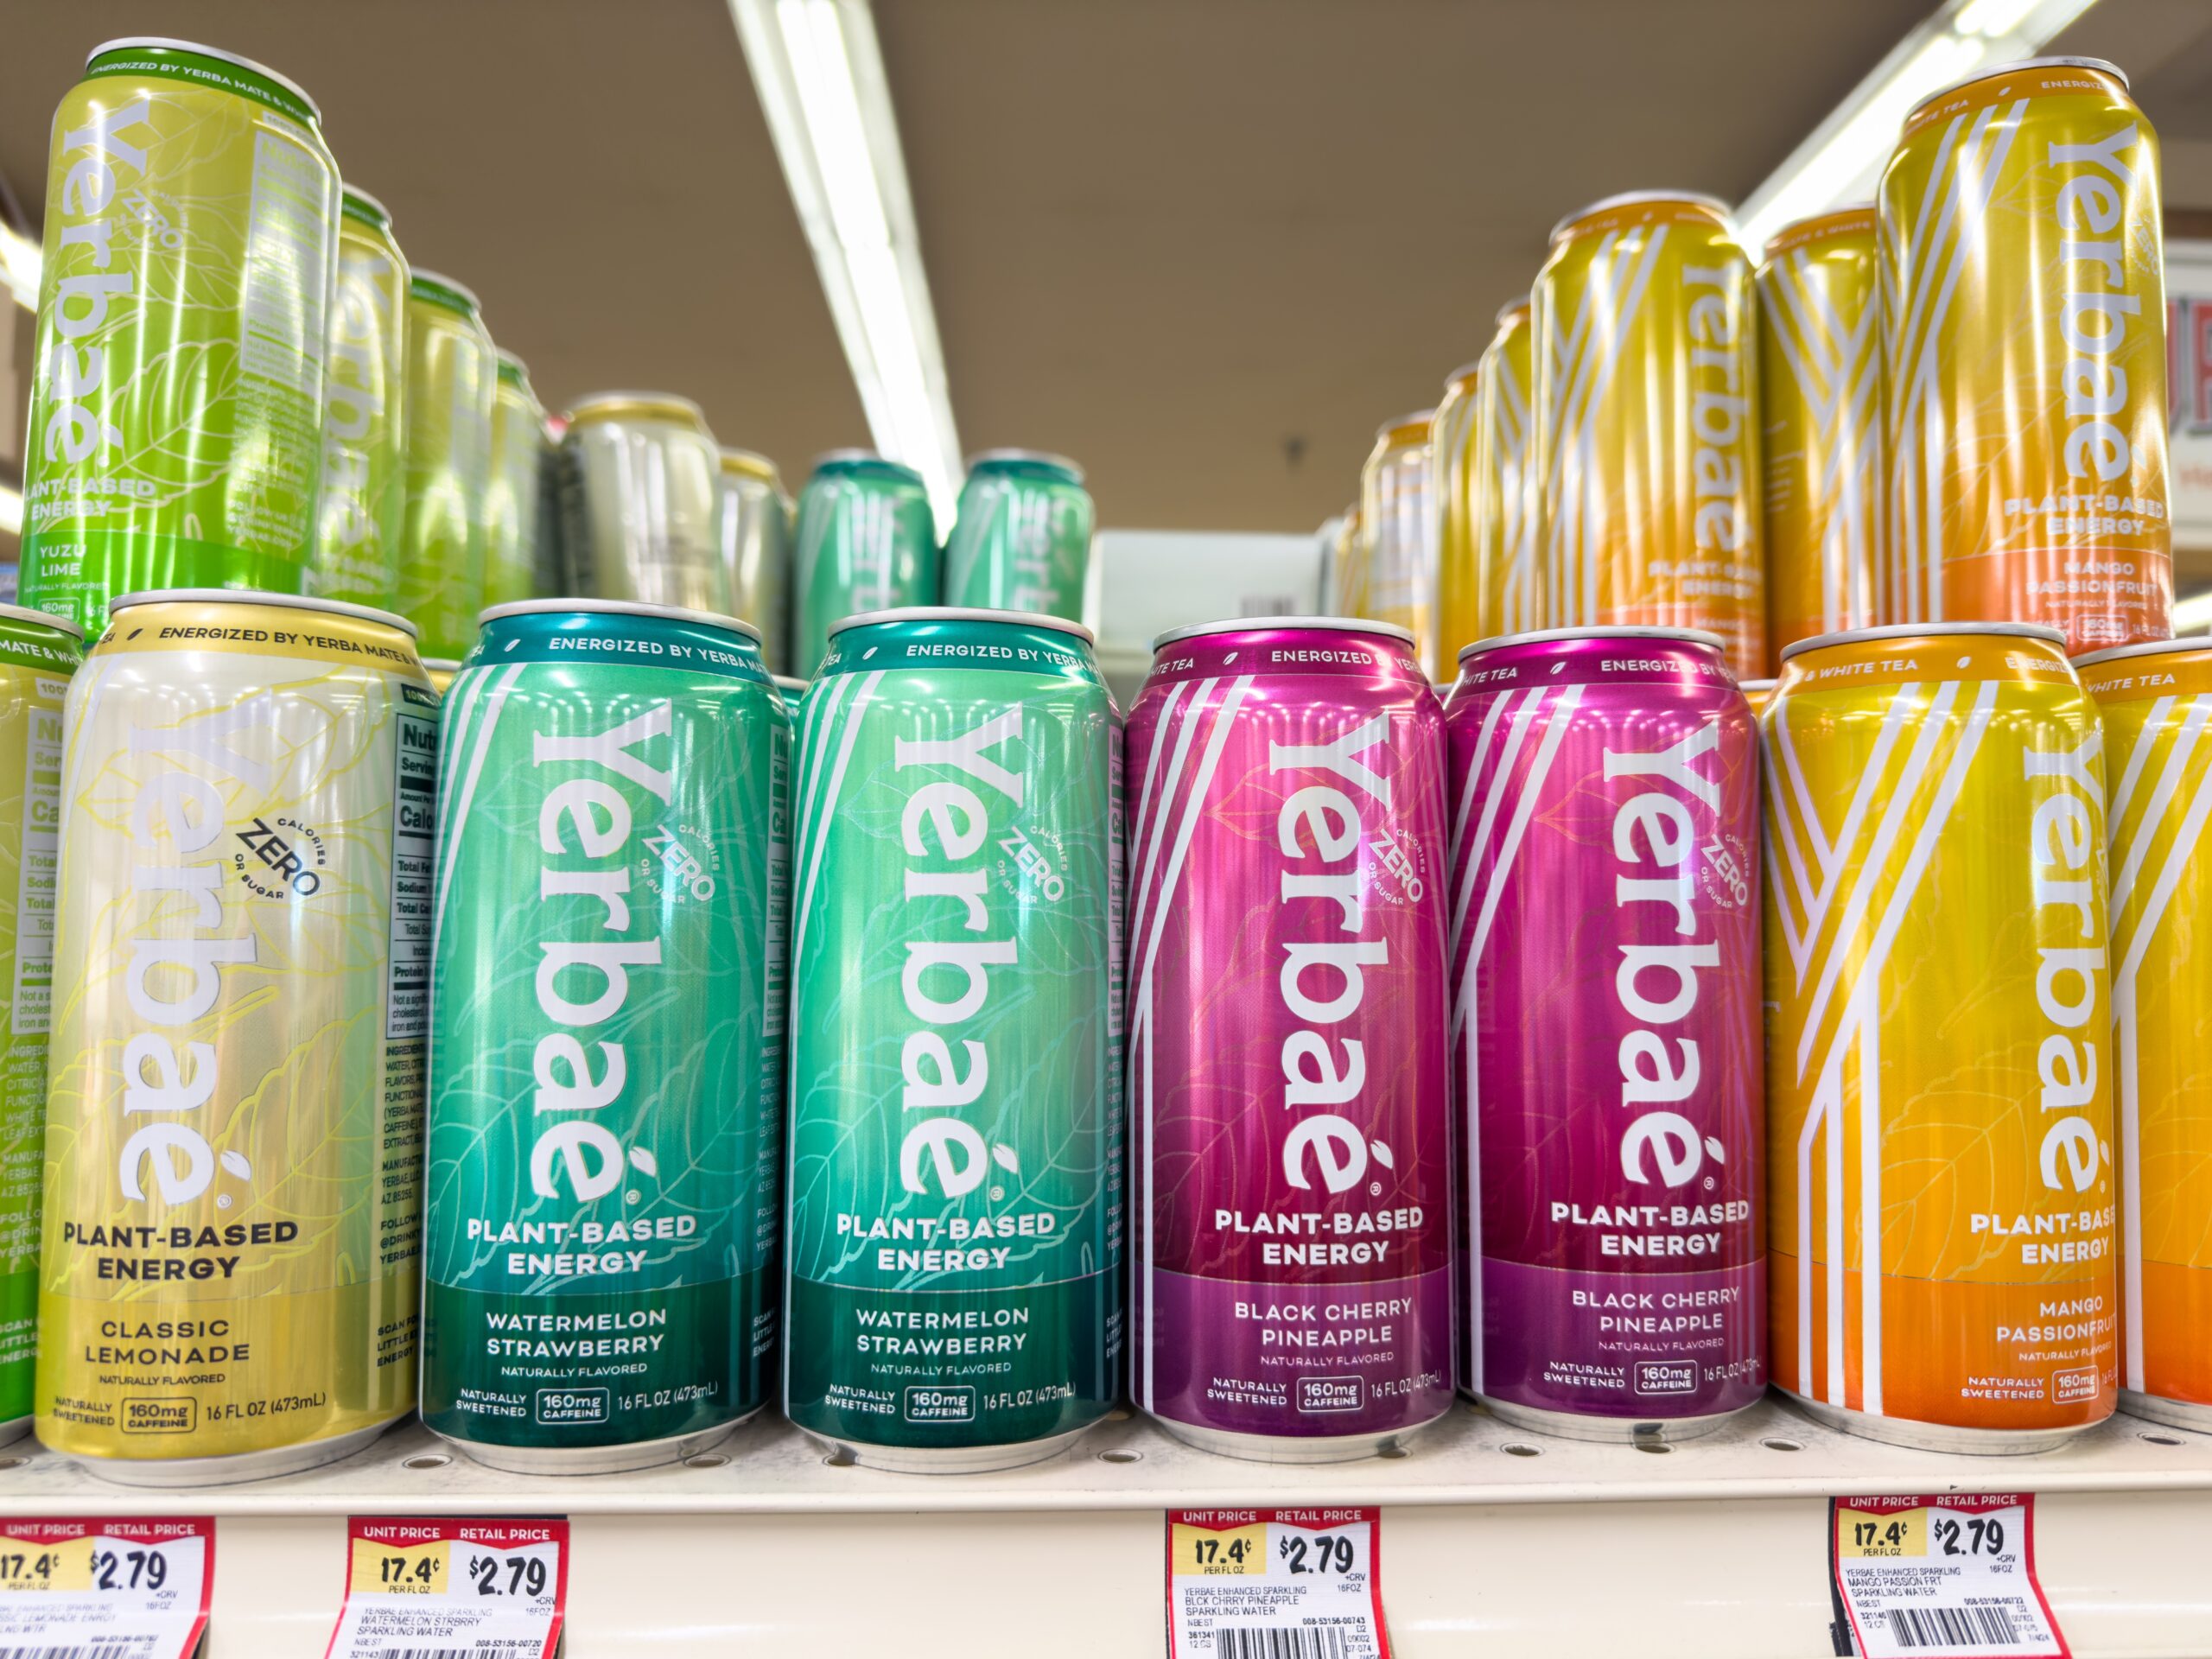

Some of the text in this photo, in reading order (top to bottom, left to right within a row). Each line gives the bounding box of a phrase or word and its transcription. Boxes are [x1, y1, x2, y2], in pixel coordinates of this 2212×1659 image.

[160, 62, 231, 86] BY YERBA
[121, 188, 184, 248] ZERO
[32, 500, 111, 520] ENERGY
[2005, 494, 2163, 518] PLANT-BASED
[2046, 518, 2145, 536] ENERGY
[40, 543, 86, 558] YUZU
[41, 563, 81, 577] LIME
[2064, 562, 2135, 575] MANGO
[159, 626, 400, 664] ENERGIZED BY YERBA MATE
[549, 637, 747, 669] ENERGIZED BY YERBA
[906, 645, 1038, 662] ENERGIZED BY
[1171, 658, 1194, 671] TEA
[1271, 651, 1372, 664] ENERGIZED
[1820, 659, 1919, 678] WHITE TEA
[277, 817, 326, 865] CALORIES
[236, 817, 321, 897] ZERO
[642, 823, 715, 901] ZERO
[997, 826, 1065, 902] ZERO
[1369, 828, 1423, 903] ZERO
[1700, 834, 1748, 907] ZERO
[242, 874, 284, 899] SUGAR
[1215, 1207, 1424, 1235] PLANT-BASED
[1551, 1200, 1749, 1228] PLANT-BASED
[1970, 1205, 2115, 1236] PLANT-BASE
[64, 1221, 299, 1249] PLANT-BASED
[467, 1215, 696, 1244] PLANT-BASED
[836, 1212, 1056, 1240] PLANT-BASED
[1262, 1241, 1389, 1266] ENERGY
[1601, 1234, 1720, 1256] ENERGY
[2022, 1236, 2108, 1264] ENERGY
[97, 1255, 241, 1281] ENERGY
[507, 1250, 648, 1276] ENERGY
[878, 1247, 1012, 1271] ENERGY
[1573, 1287, 1740, 1310] BLACK CHERRY
[2040, 1296, 2103, 1318] MANGO
[855, 1307, 1029, 1330] WATERMELON
[1235, 1298, 1412, 1321] BLACK CHERRY
[100, 1319, 230, 1339] CLASSIC
[486, 1308, 667, 1332] WATERMELON
[1600, 1313, 1723, 1333] PINEAPPLE
[856, 1333, 1027, 1356] STRAWBERRY
[1262, 1325, 1393, 1347] PINEAPPLE
[486, 1334, 664, 1357] STRAWBERRY
[86, 1343, 251, 1367] LEMONADE
[1261, 1352, 1394, 1367] NATURALLY FLAVORED
[501, 1363, 647, 1378] NATURALLY FLAVORED
[871, 1362, 1012, 1376] NATURALLY FLAVORED
[1549, 1361, 1624, 1377] NATURALLY
[1641, 1366, 1691, 1381] 160mg
[99, 1373, 226, 1385] NATURALLY FLAVORED
[1213, 1376, 1287, 1394] NATURALLY
[1543, 1372, 1624, 1388] SWEETENED
[1641, 1379, 1692, 1389] CAFFEINE
[1968, 1376, 2044, 1389] NATURALLY
[2058, 1374, 2095, 1387] 160mg
[461, 1388, 527, 1404] NATURALLY
[618, 1381, 719, 1410] 16 FL OZ (473mL)
[830, 1383, 896, 1402] NATURALLY
[1207, 1389, 1287, 1406] SWEETENED
[1304, 1383, 1357, 1397] 160mg
[1961, 1387, 2044, 1399] SWEETENED
[2058, 1384, 2095, 1398] CAFFEINE
[54, 1395, 112, 1413] NATURALLY
[206, 1392, 327, 1421] 16 FL OZ (473mL)
[455, 1399, 527, 1417] SWEETENED
[543, 1395, 602, 1409] 160mg
[824, 1395, 896, 1415] SWEETENED
[912, 1393, 968, 1408] 160mg
[1304, 1395, 1357, 1407] CAFFEINE
[53, 1408, 115, 1427] SWEETENED
[129, 1403, 188, 1420] 160mg
[543, 1408, 602, 1419] CAFFEINE
[912, 1406, 968, 1417] CAFFEINE
[128, 1418, 188, 1428] CAFFEINE
[1850, 1497, 1919, 1507] UNIT PRICE
[1936, 1495, 2018, 1506] RETAIL PRICE
[1183, 1511, 1256, 1521] UNIT PRICE
[1275, 1510, 1362, 1521] RETAIL PRICE
[7, 1524, 85, 1535] UNIT PRICE
[104, 1524, 195, 1535] RETAIL PRICE
[364, 1527, 441, 1538] UNIT PRICE
[460, 1528, 550, 1541] RETAIL PRICE
[1855, 1522, 1907, 1547] 17.4¢
[1934, 1518, 2004, 1556] $2.79
[1195, 1538, 1252, 1564] 17.4¢
[1280, 1535, 1354, 1574] $2.79
[90, 1550, 167, 1590] $2.79
[381, 1557, 440, 1583] 17.4¢
[469, 1555, 546, 1596] $2.79
[1233, 1566, 1244, 1574] OZ
[1344, 1573, 1366, 1582] +CRV
[1848, 1576, 1942, 1587] MANGO PASSION FRT
[1185, 1586, 1307, 1596] YERBAE ENHANCED SPARKLING
[1852, 1587, 1937, 1598] SPARKLING WATER
[1185, 1596, 1300, 1605] BLCK CHRRY PINEAPPLE
[1185, 1606, 1276, 1616] SPARKLING WATER
[360, 1616, 482, 1627] WATERMELON STRBRRY
[358, 1626, 453, 1637] SPARKLING WATER
